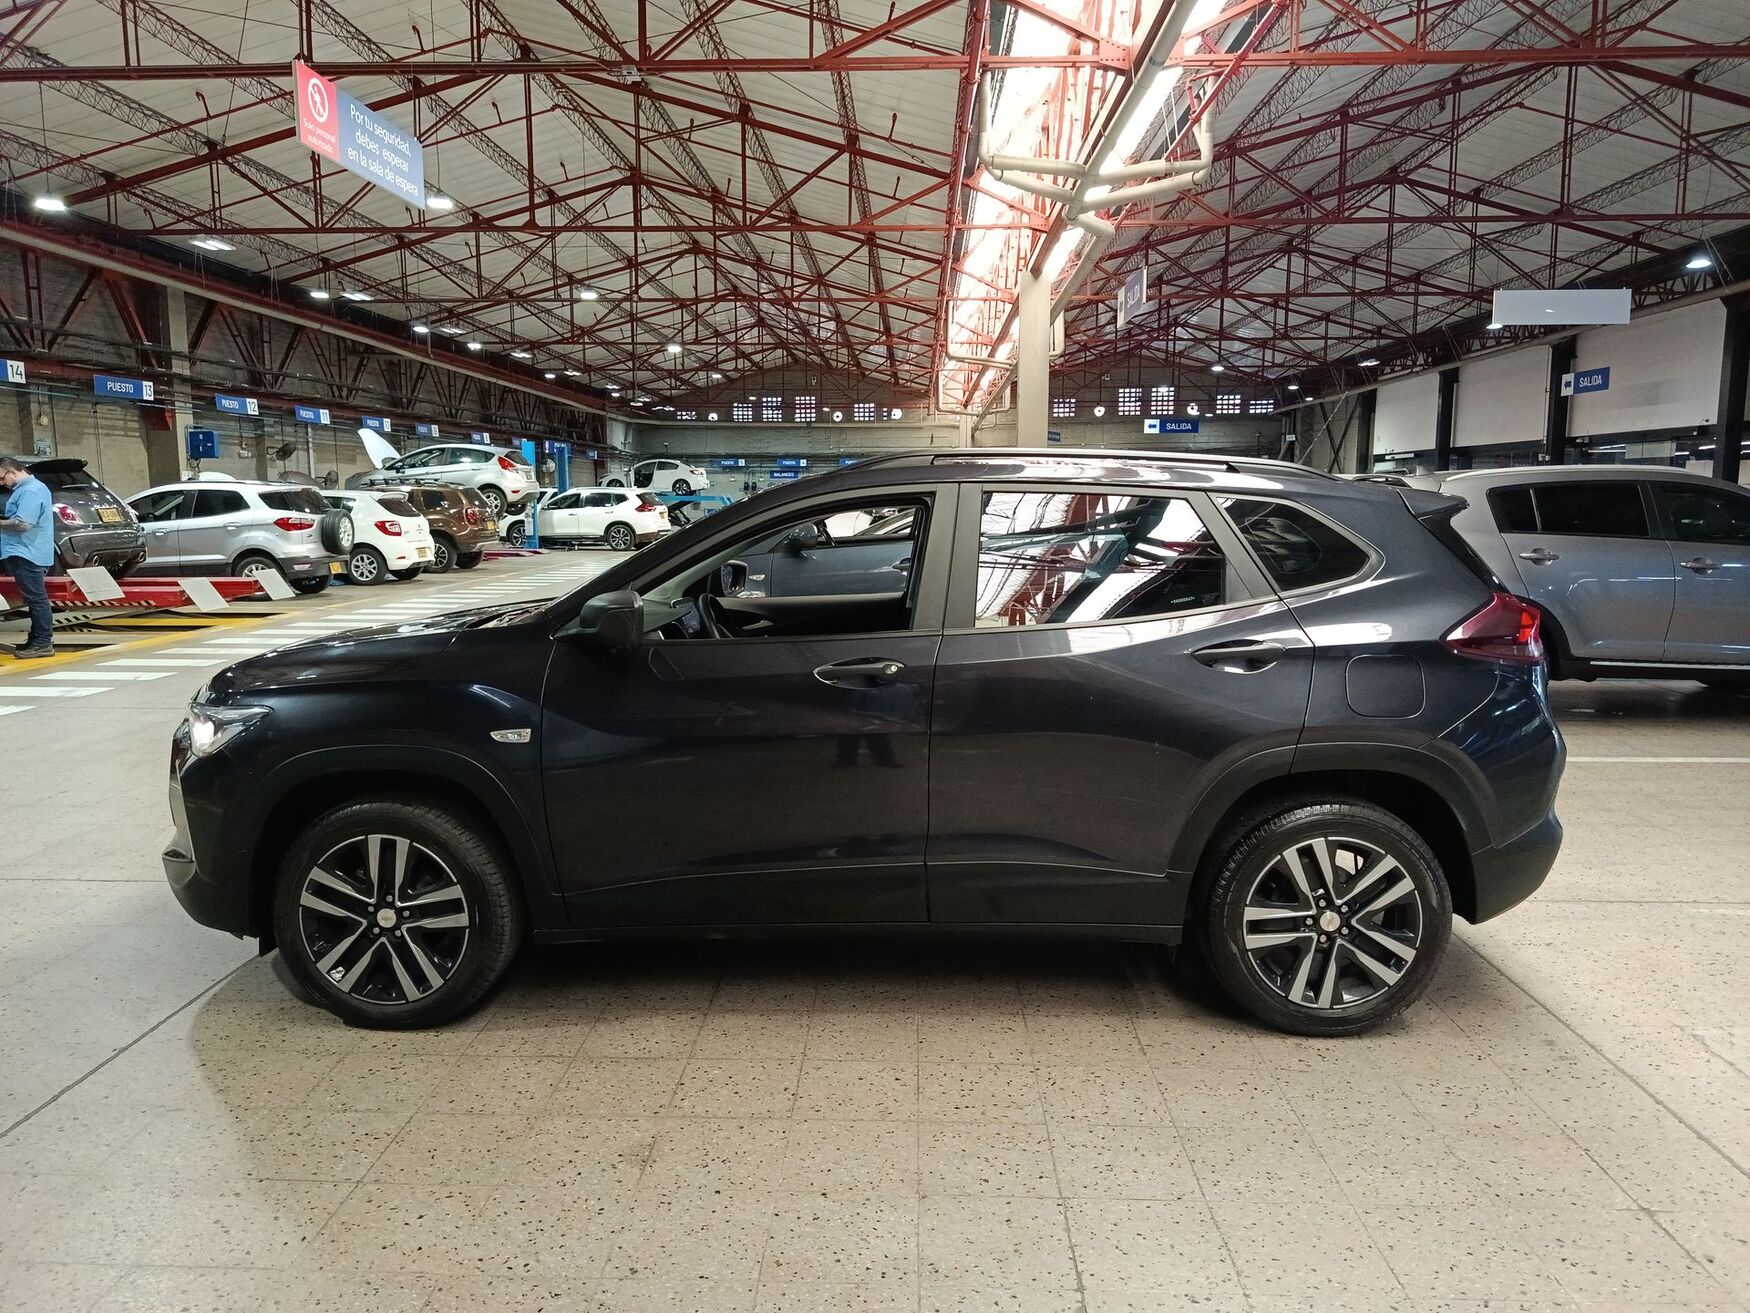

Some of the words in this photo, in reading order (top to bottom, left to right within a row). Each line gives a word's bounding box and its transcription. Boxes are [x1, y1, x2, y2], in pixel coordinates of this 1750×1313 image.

[350, 103, 365, 125] Por
[365, 117, 373, 132] tu
[374, 122, 411, 158] seguridad,
[355, 128, 380, 155] debes
[383, 148, 409, 174] esperar
[347, 147, 359, 163] en
[360, 153, 368, 168] la
[368, 158, 384, 178] sala
[385, 165, 395, 184] de
[395, 175, 419, 197] espera
[9, 364, 23, 380] 14
[107, 381, 134, 393] PUESTO
[144, 384, 153, 397] 13
[1579, 375, 1602, 387] SALIDA
[221, 398, 239, 409] PUESTO
[248, 401, 257, 412] 12
[1166, 422, 1192, 430] SALIDA
